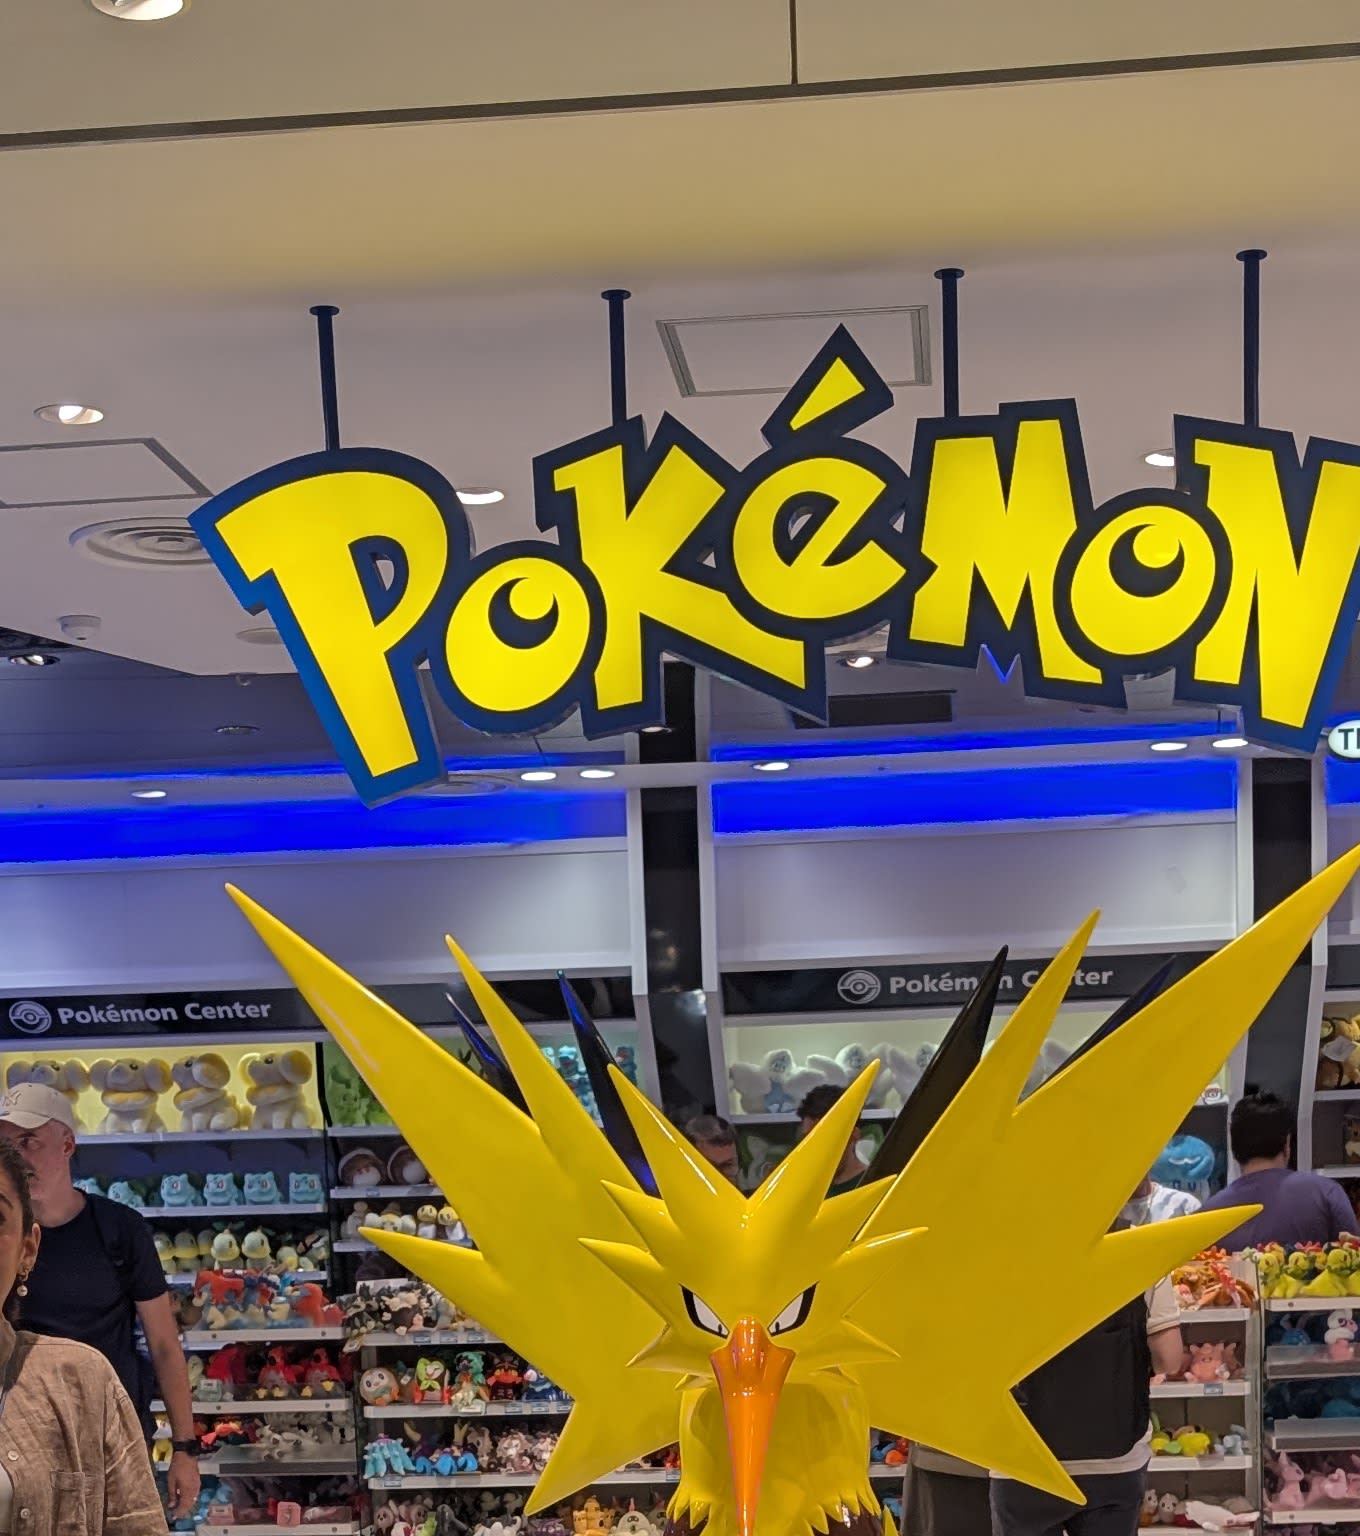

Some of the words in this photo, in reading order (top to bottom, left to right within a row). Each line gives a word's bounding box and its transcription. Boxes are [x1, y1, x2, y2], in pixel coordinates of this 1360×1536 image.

[890, 971, 1013, 994] Pokémn
[1021, 969, 1114, 989] Cter
[58, 1003, 178, 1025] Pokémon
[184, 1001, 272, 1020] Center
